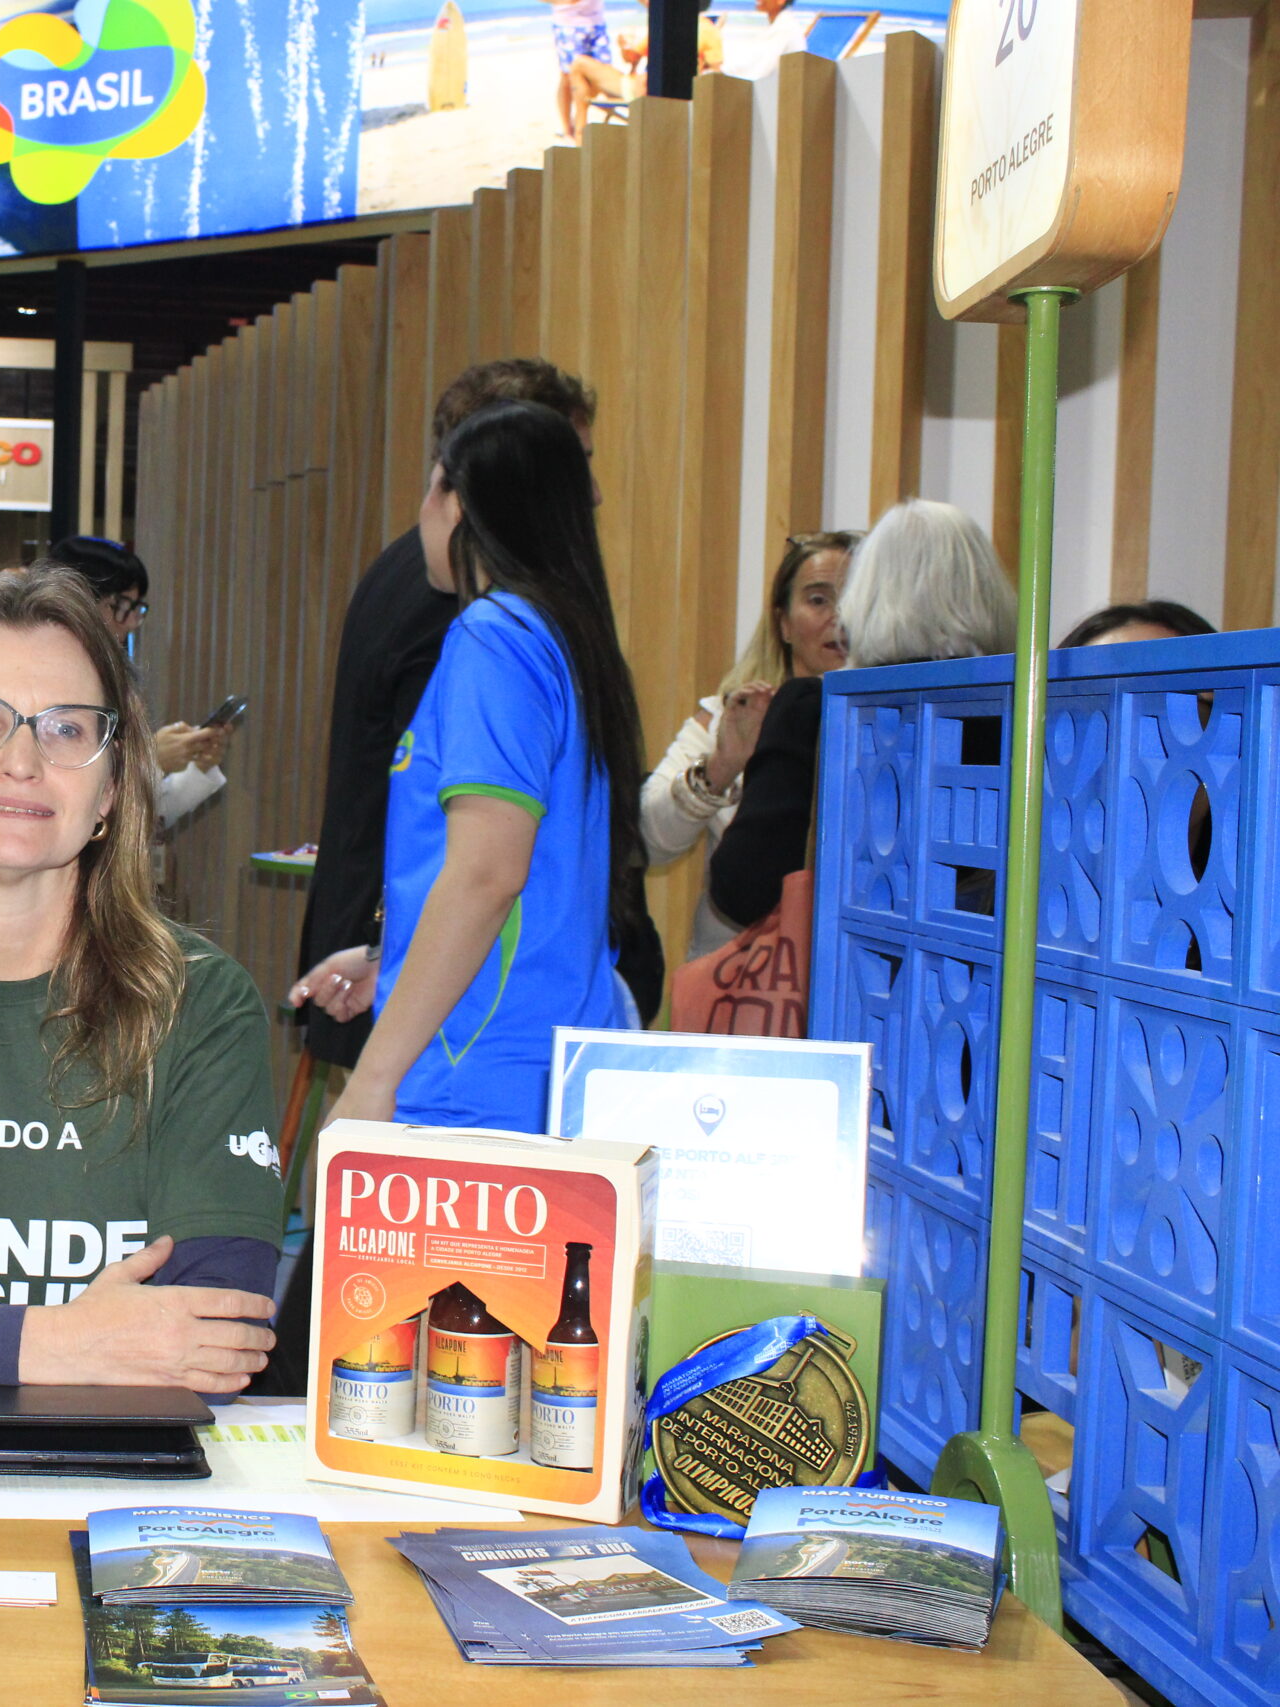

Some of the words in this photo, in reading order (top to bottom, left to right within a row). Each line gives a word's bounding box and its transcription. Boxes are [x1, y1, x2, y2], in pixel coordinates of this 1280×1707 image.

[20, 69, 154, 120] BRASIL
[970, 155, 1007, 207] PORTO
[1007, 113, 1054, 178] ALEGRE
[57, 1122, 83, 1150] A
[674, 1148, 732, 1164] PORTO
[340, 1168, 548, 1237] PORTO
[339, 1225, 417, 1258] ALCAPONE
[461, 1242, 495, 1251] REPRESENTA
[335, 1380, 388, 1400] PORTO
[426, 1393, 476, 1415] PORTO
[660, 1416, 684, 1438] DE
[683, 1432, 740, 1473] PORTO
[702, 1409, 795, 1476] MARATONA
[469, 1471, 492, 1479] LONG
[799, 1507, 944, 1526] PortoAlegre
[138, 1525, 276, 1537] PortoAlegre
[460, 1548, 550, 1562] CORRIDAS
[570, 1545, 595, 1555] DE
[595, 1542, 638, 1554] RUA
